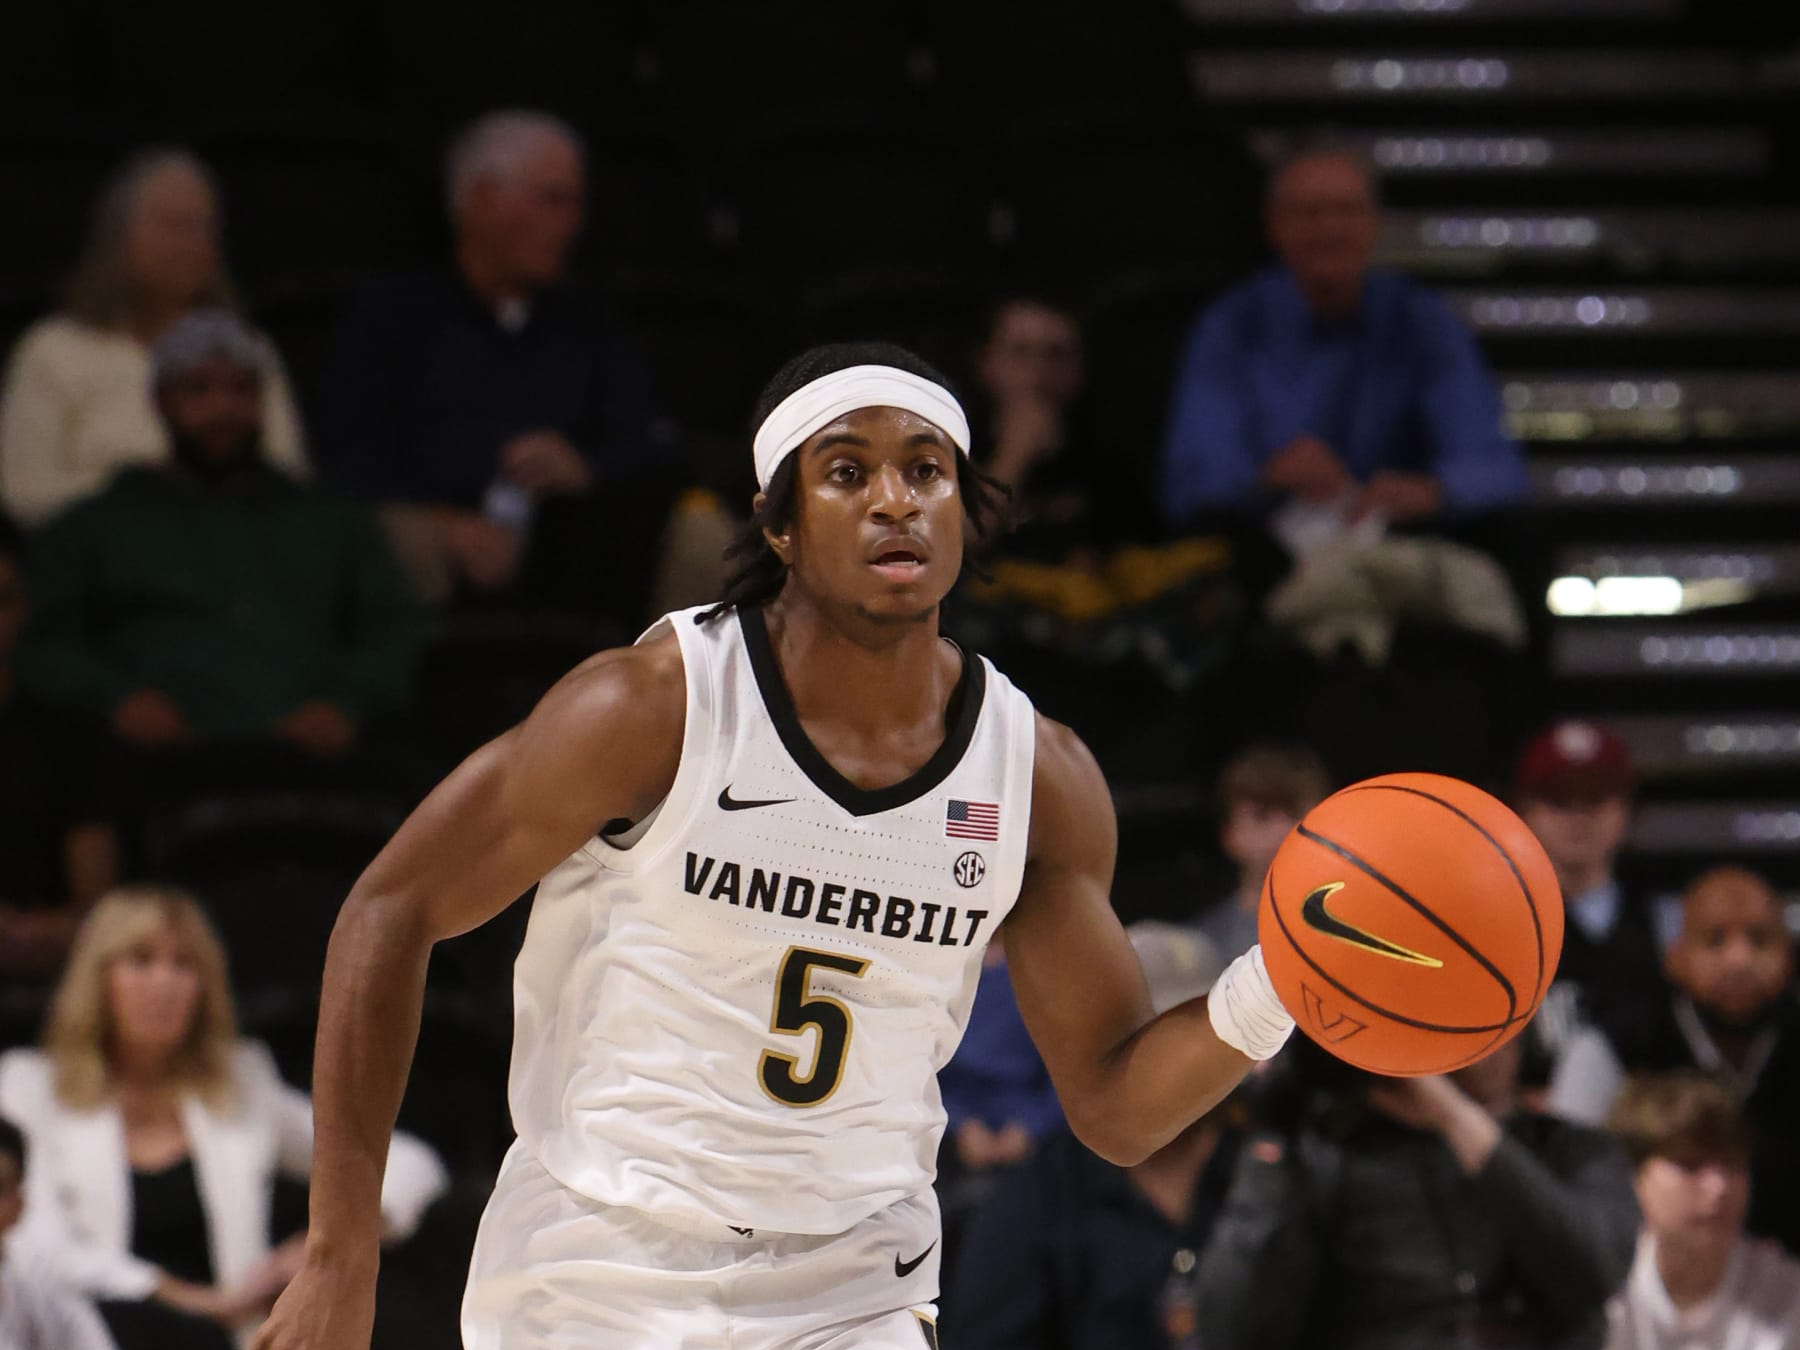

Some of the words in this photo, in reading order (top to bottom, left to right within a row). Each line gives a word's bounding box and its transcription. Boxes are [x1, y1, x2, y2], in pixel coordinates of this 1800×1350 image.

[684, 851, 988, 947] VANDERBILT
[954, 851, 985, 888] SEC
[757, 945, 873, 1108] 5
